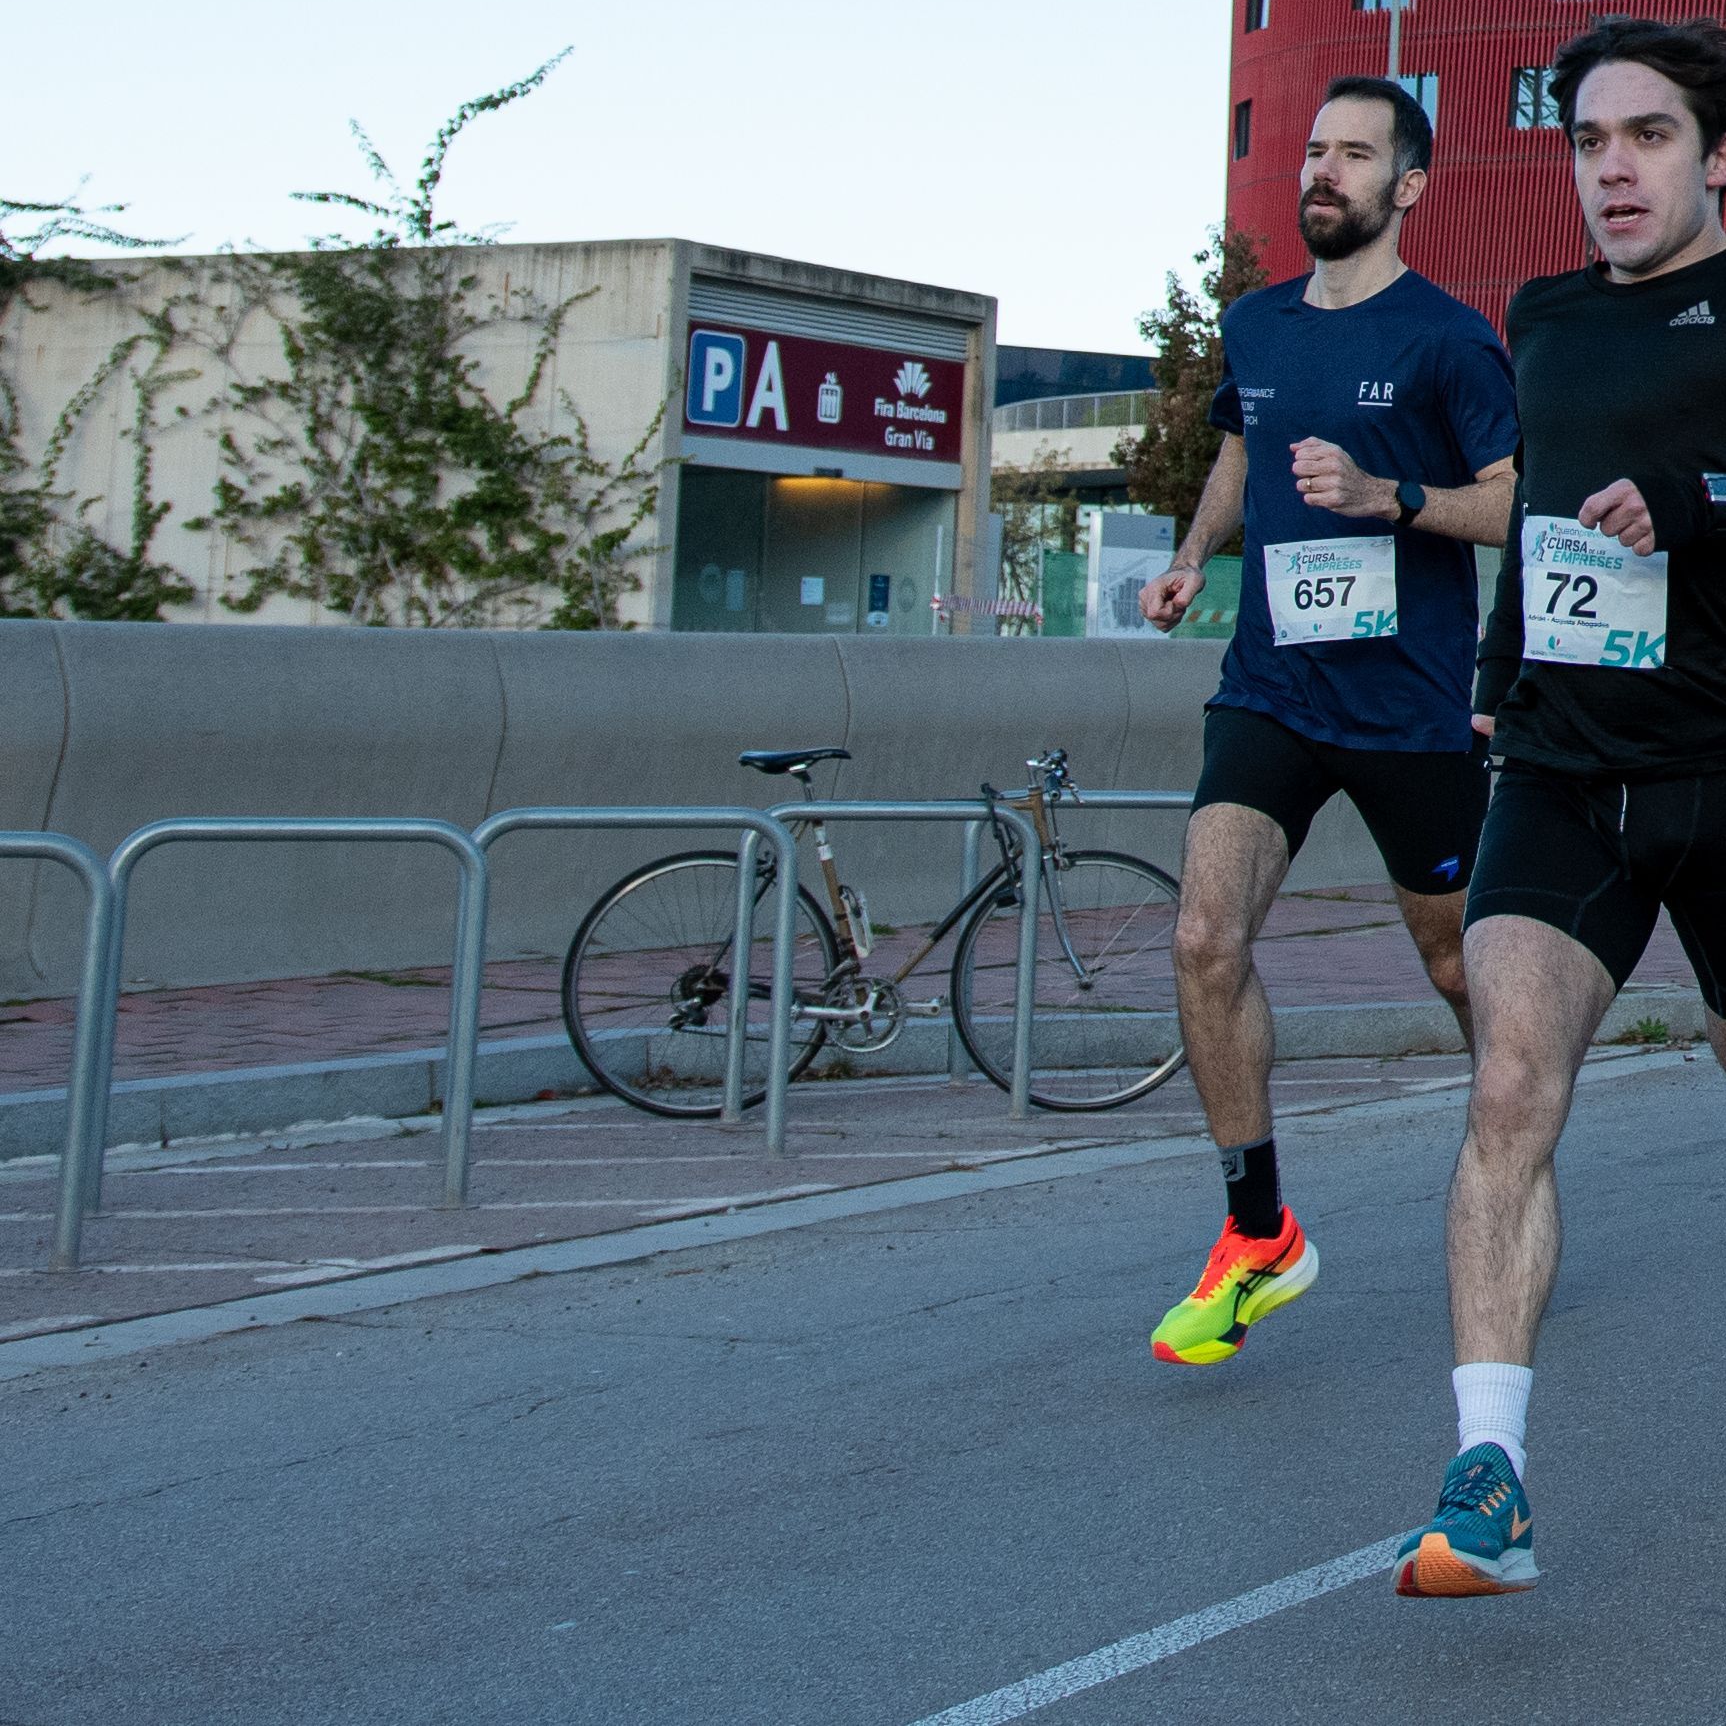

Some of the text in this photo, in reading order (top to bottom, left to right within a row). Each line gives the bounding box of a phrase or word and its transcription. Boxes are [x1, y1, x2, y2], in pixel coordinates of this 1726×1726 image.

[1669, 315, 1716, 326] adidas
[702, 346, 734, 412] P
[746, 341, 789, 431] A
[1358, 381, 1394, 400] FAR
[874, 398, 947, 424] Fira Barcelona
[884, 427, 912, 448] Gran
[1547, 537, 1587, 553] CURSA
[1302, 553, 1335, 564] CURSA
[1307, 560, 1363, 573] EMPRESES
[1552, 551, 1624, 570] EMPRESES
[1295, 576, 1356, 610] 657
[1546, 571, 1598, 618] 72
[1351, 609, 1397, 639] 5K
[1599, 629, 1666, 668] 5K
